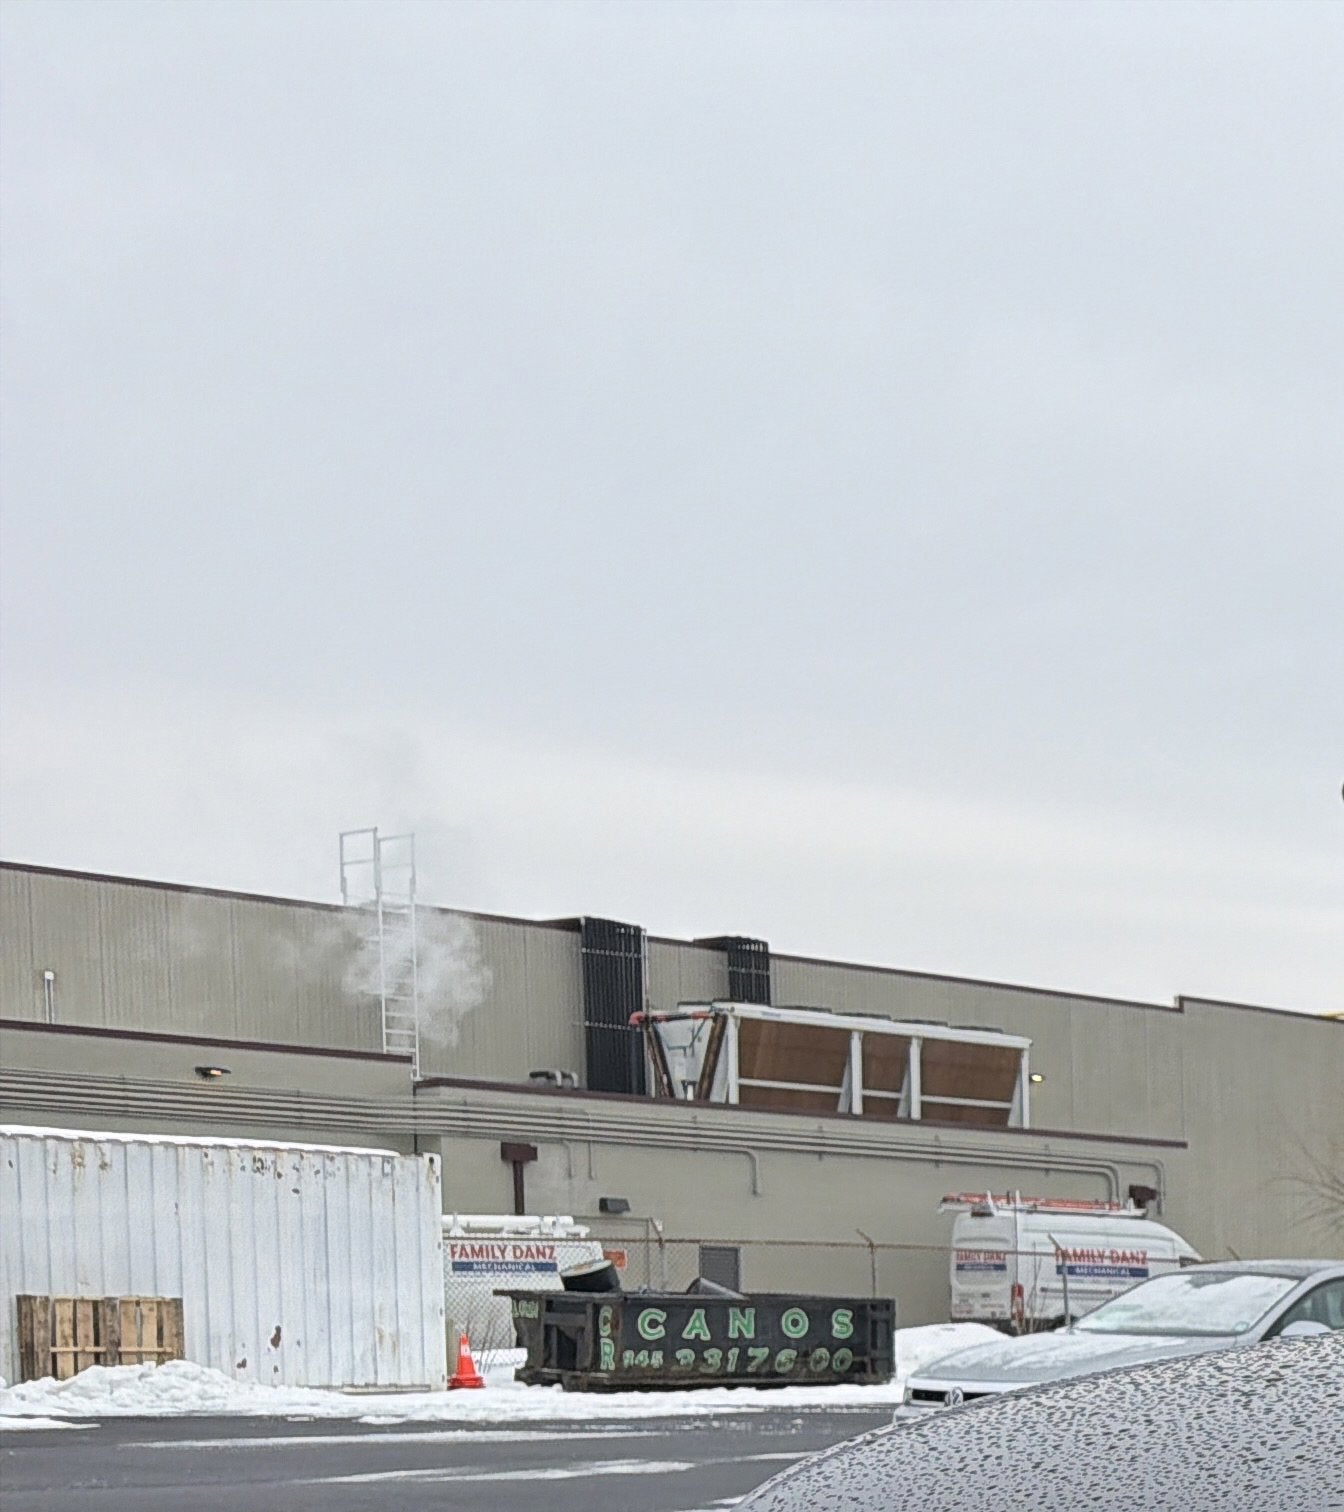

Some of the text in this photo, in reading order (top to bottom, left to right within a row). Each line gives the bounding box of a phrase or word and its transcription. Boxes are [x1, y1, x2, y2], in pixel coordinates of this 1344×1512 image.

[450, 1243, 557, 1260] FAMILY DANZ
[1055, 1247, 1148, 1265] FAMILY DANZ
[637, 1307, 854, 1341] CANOS
